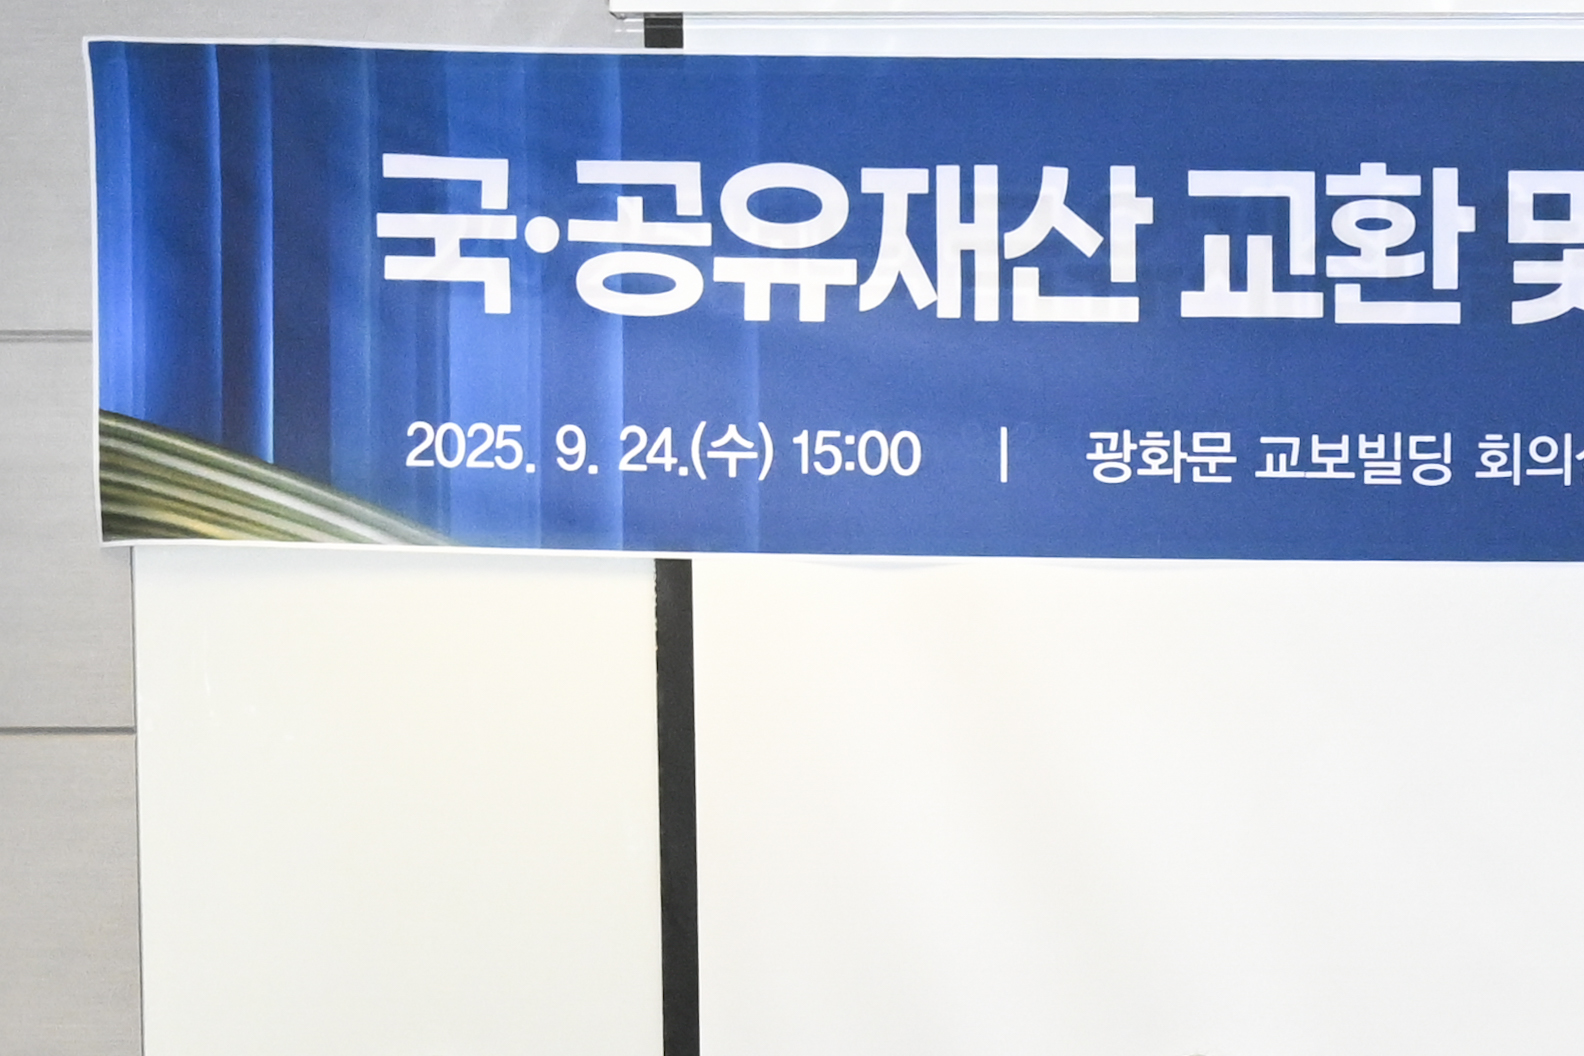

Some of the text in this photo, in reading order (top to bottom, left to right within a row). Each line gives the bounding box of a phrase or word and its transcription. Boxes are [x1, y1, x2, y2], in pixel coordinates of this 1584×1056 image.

[377, 153, 1154, 323] 국·공유재산
[1180, 162, 1476, 325] 교환
[405, 420, 536, 474] 2025.
[555, 424, 599, 475] 9.
[618, 420, 774, 481] 24.(수)
[792, 429, 922, 477] 15:00
[1086, 429, 1237, 484] 광화문
[1254, 431, 1452, 486] 교보빌딩
